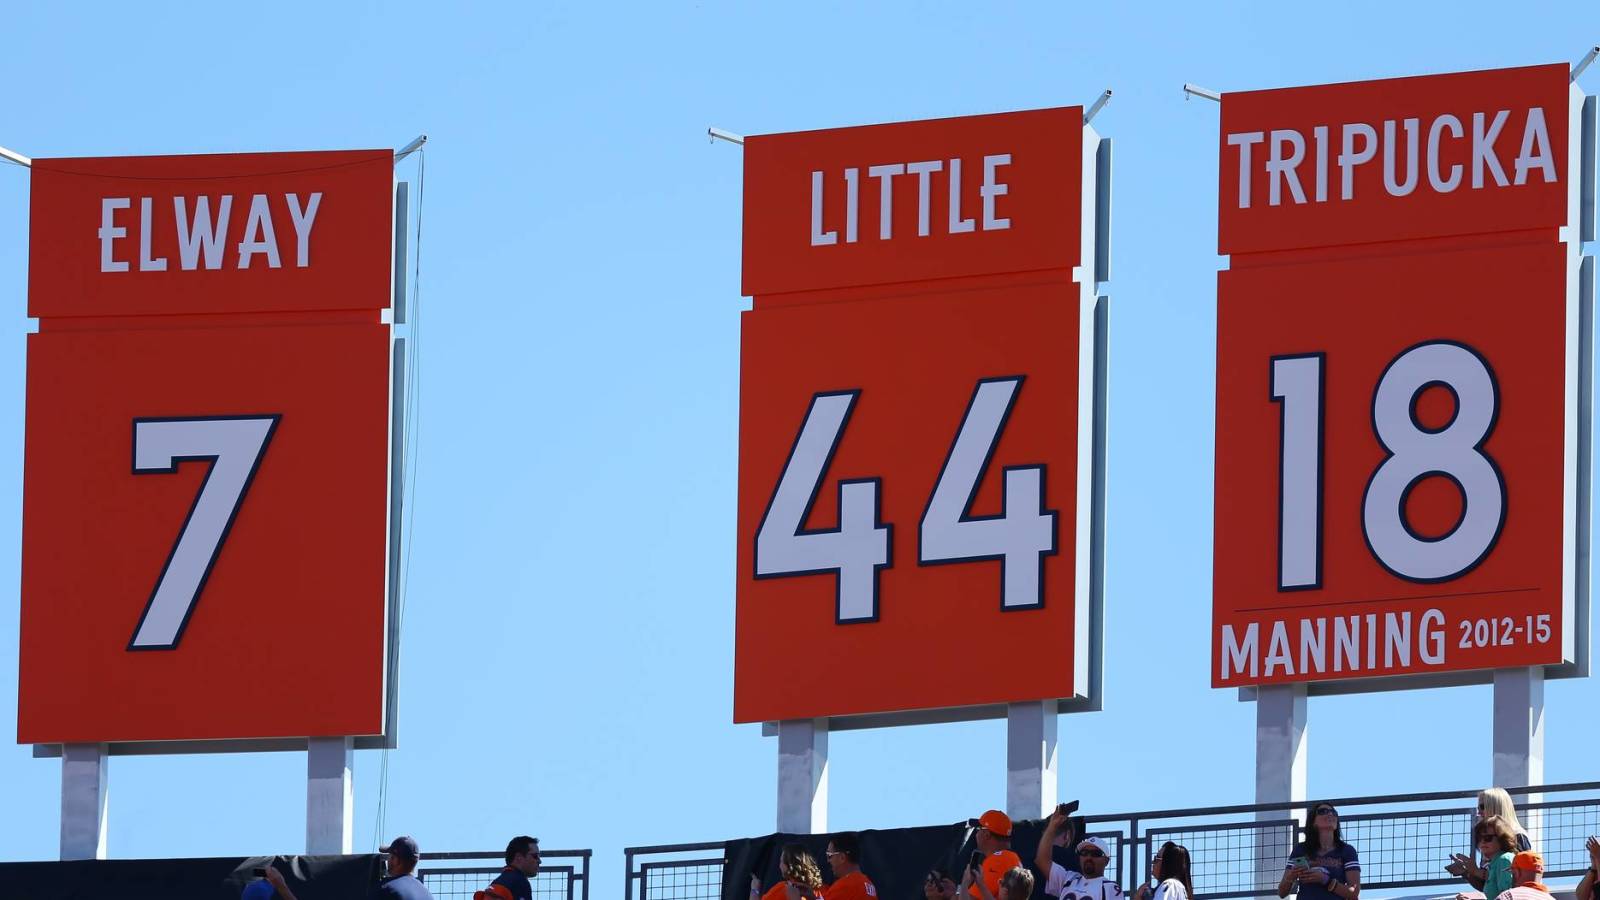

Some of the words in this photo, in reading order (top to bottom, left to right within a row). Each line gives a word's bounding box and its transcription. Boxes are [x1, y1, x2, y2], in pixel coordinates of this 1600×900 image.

[810, 153, 1011, 247] LITTLE
[1227, 107, 1557, 209] TRIPUCKA
[98, 192, 323, 273] ELWAY
[753, 375, 1059, 624] 44
[1269, 339, 1507, 593] 18
[127, 414, 281, 651] 7
[1220, 608, 1447, 680] MANNING
[1458, 614, 1552, 649] 2012-15
